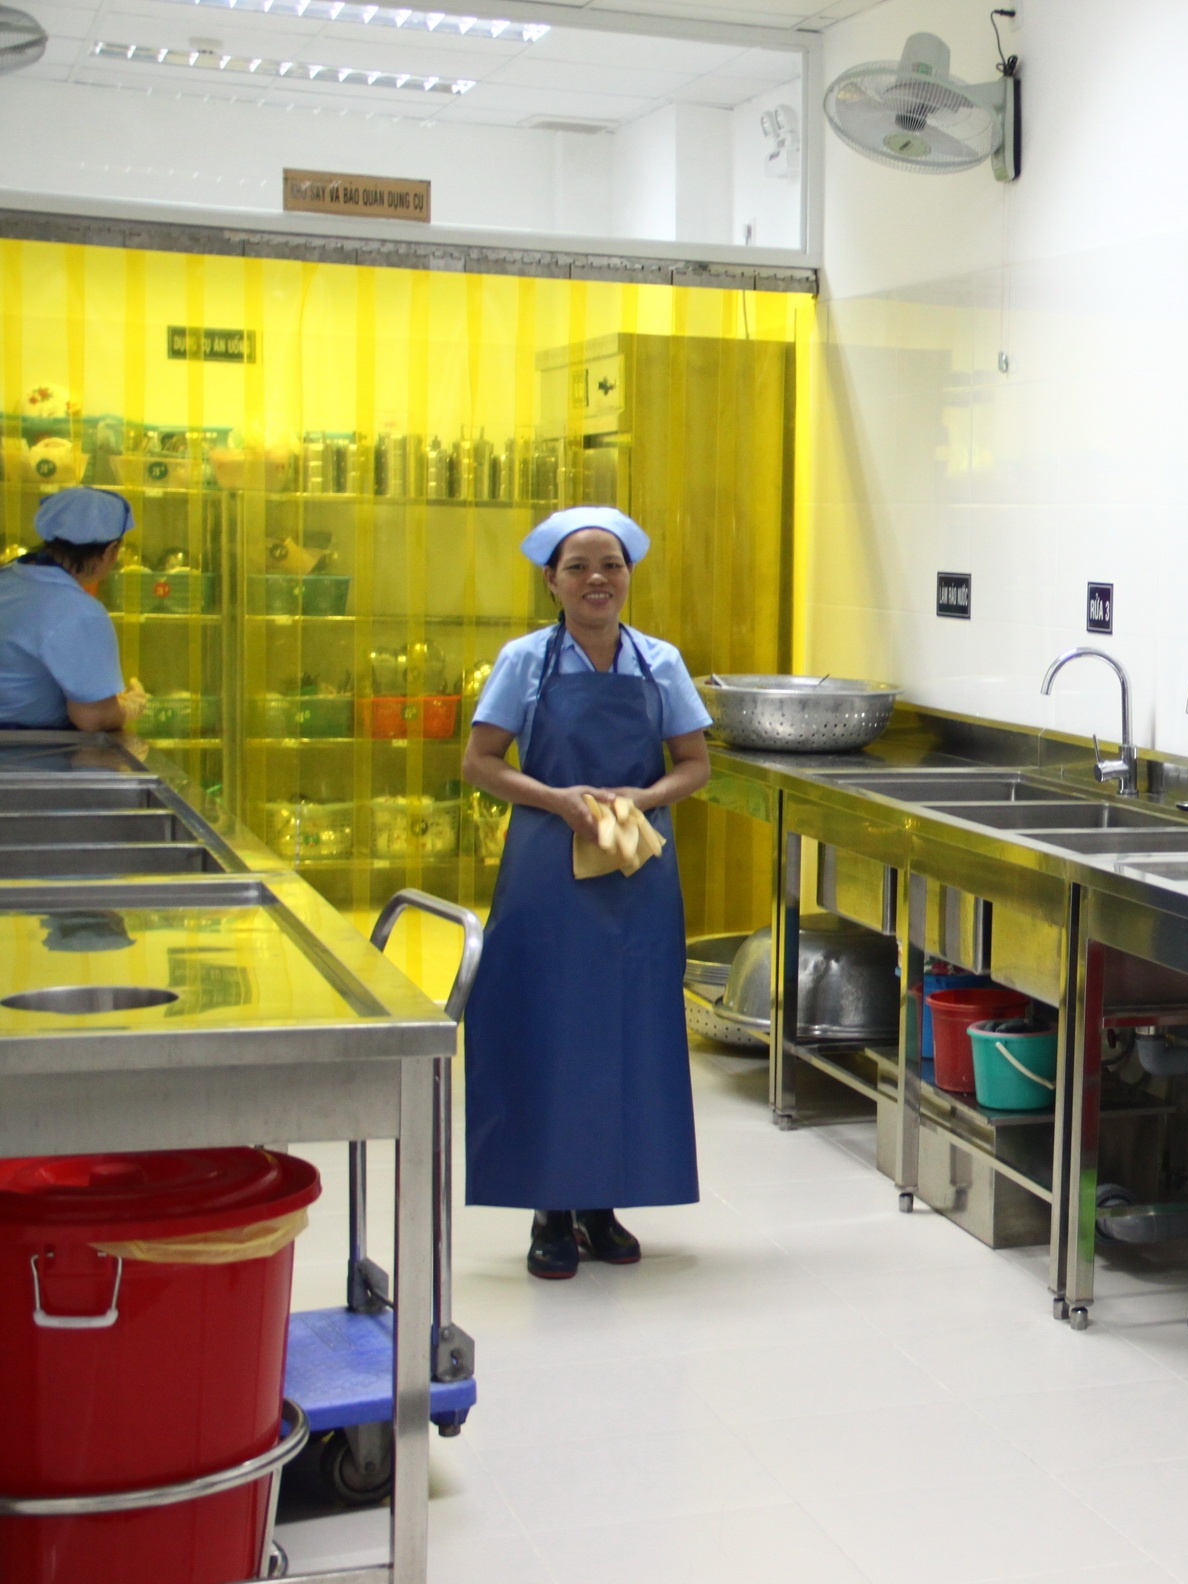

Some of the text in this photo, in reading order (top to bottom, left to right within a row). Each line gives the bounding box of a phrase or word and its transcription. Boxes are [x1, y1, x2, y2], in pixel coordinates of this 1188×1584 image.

[343, 181, 360, 205] BẢO
[387, 190, 411, 212] DỤNG
[413, 192, 424, 213] CỤ
[1090, 592, 1110, 622] RỬA 3
